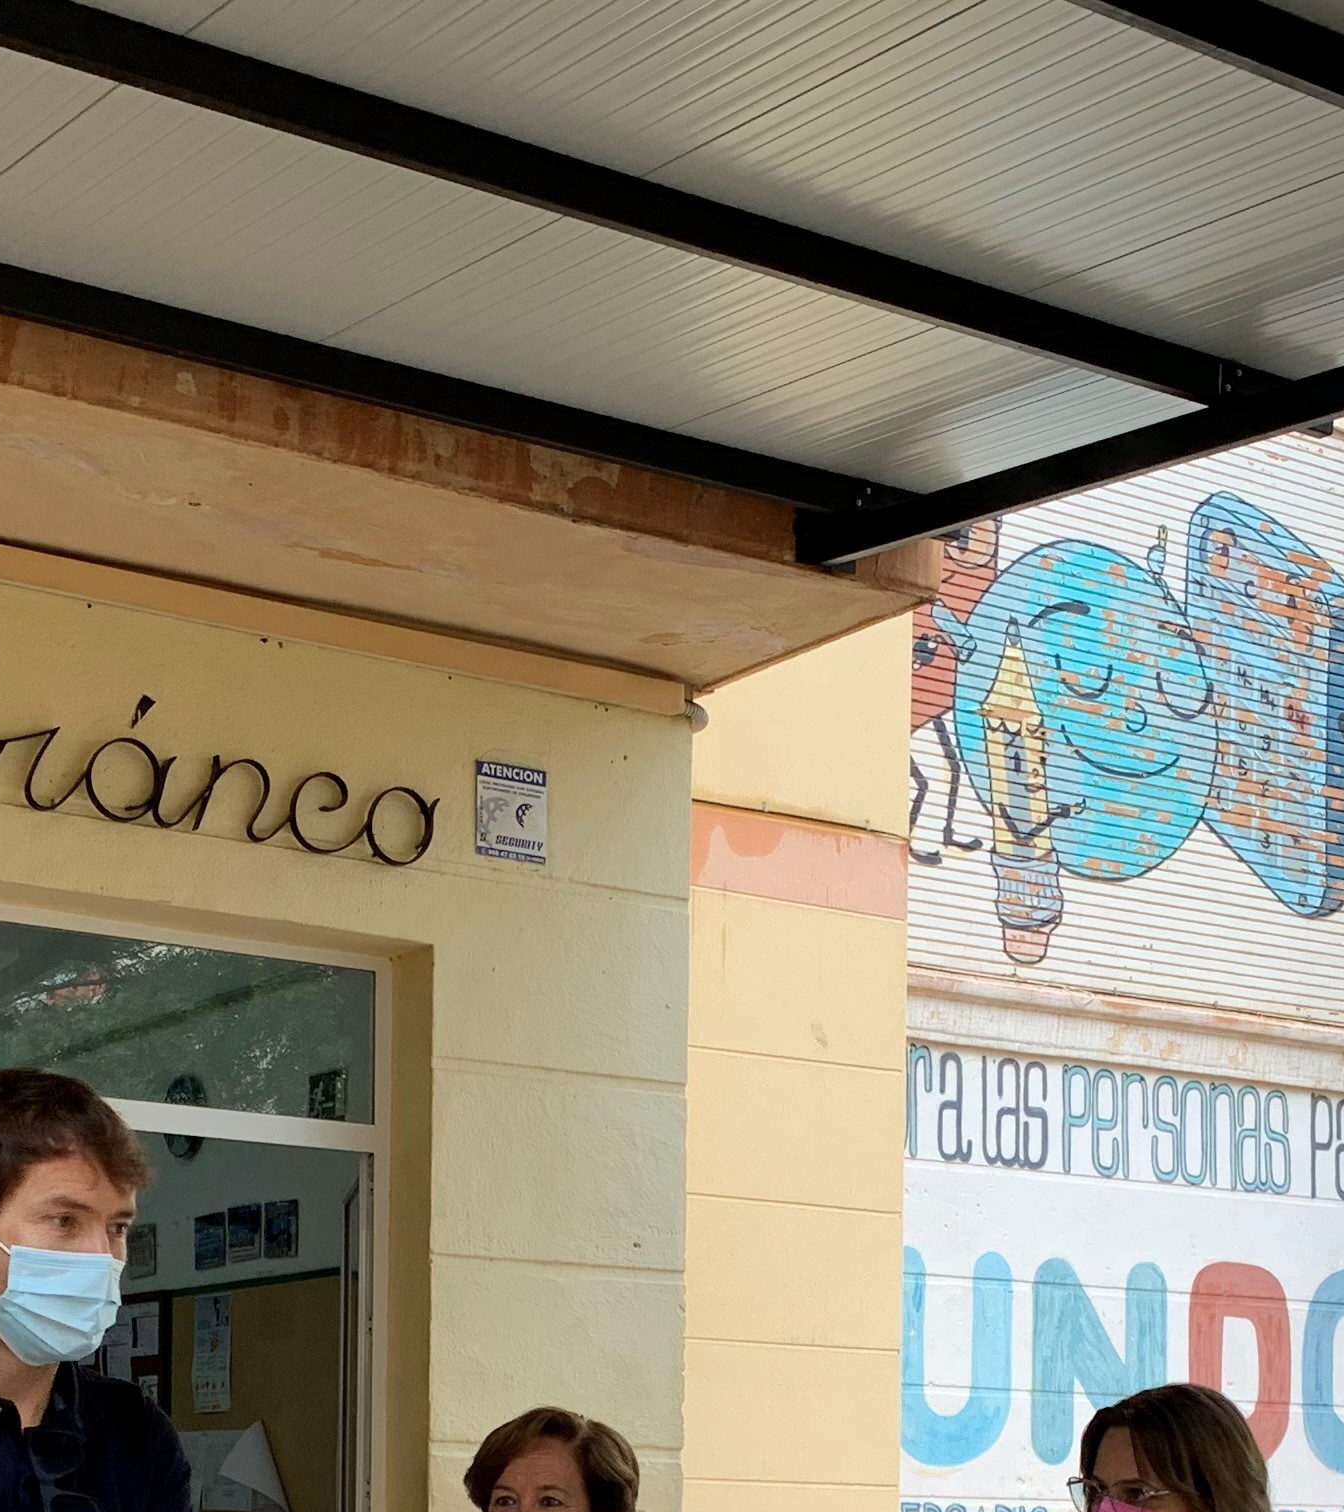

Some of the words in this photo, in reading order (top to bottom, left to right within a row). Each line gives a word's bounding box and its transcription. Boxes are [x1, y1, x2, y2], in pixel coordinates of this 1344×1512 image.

[481, 762, 544, 785] ATENCION
[495, 834, 544, 852] SECURITY
[981, 1055, 1049, 1170] las
